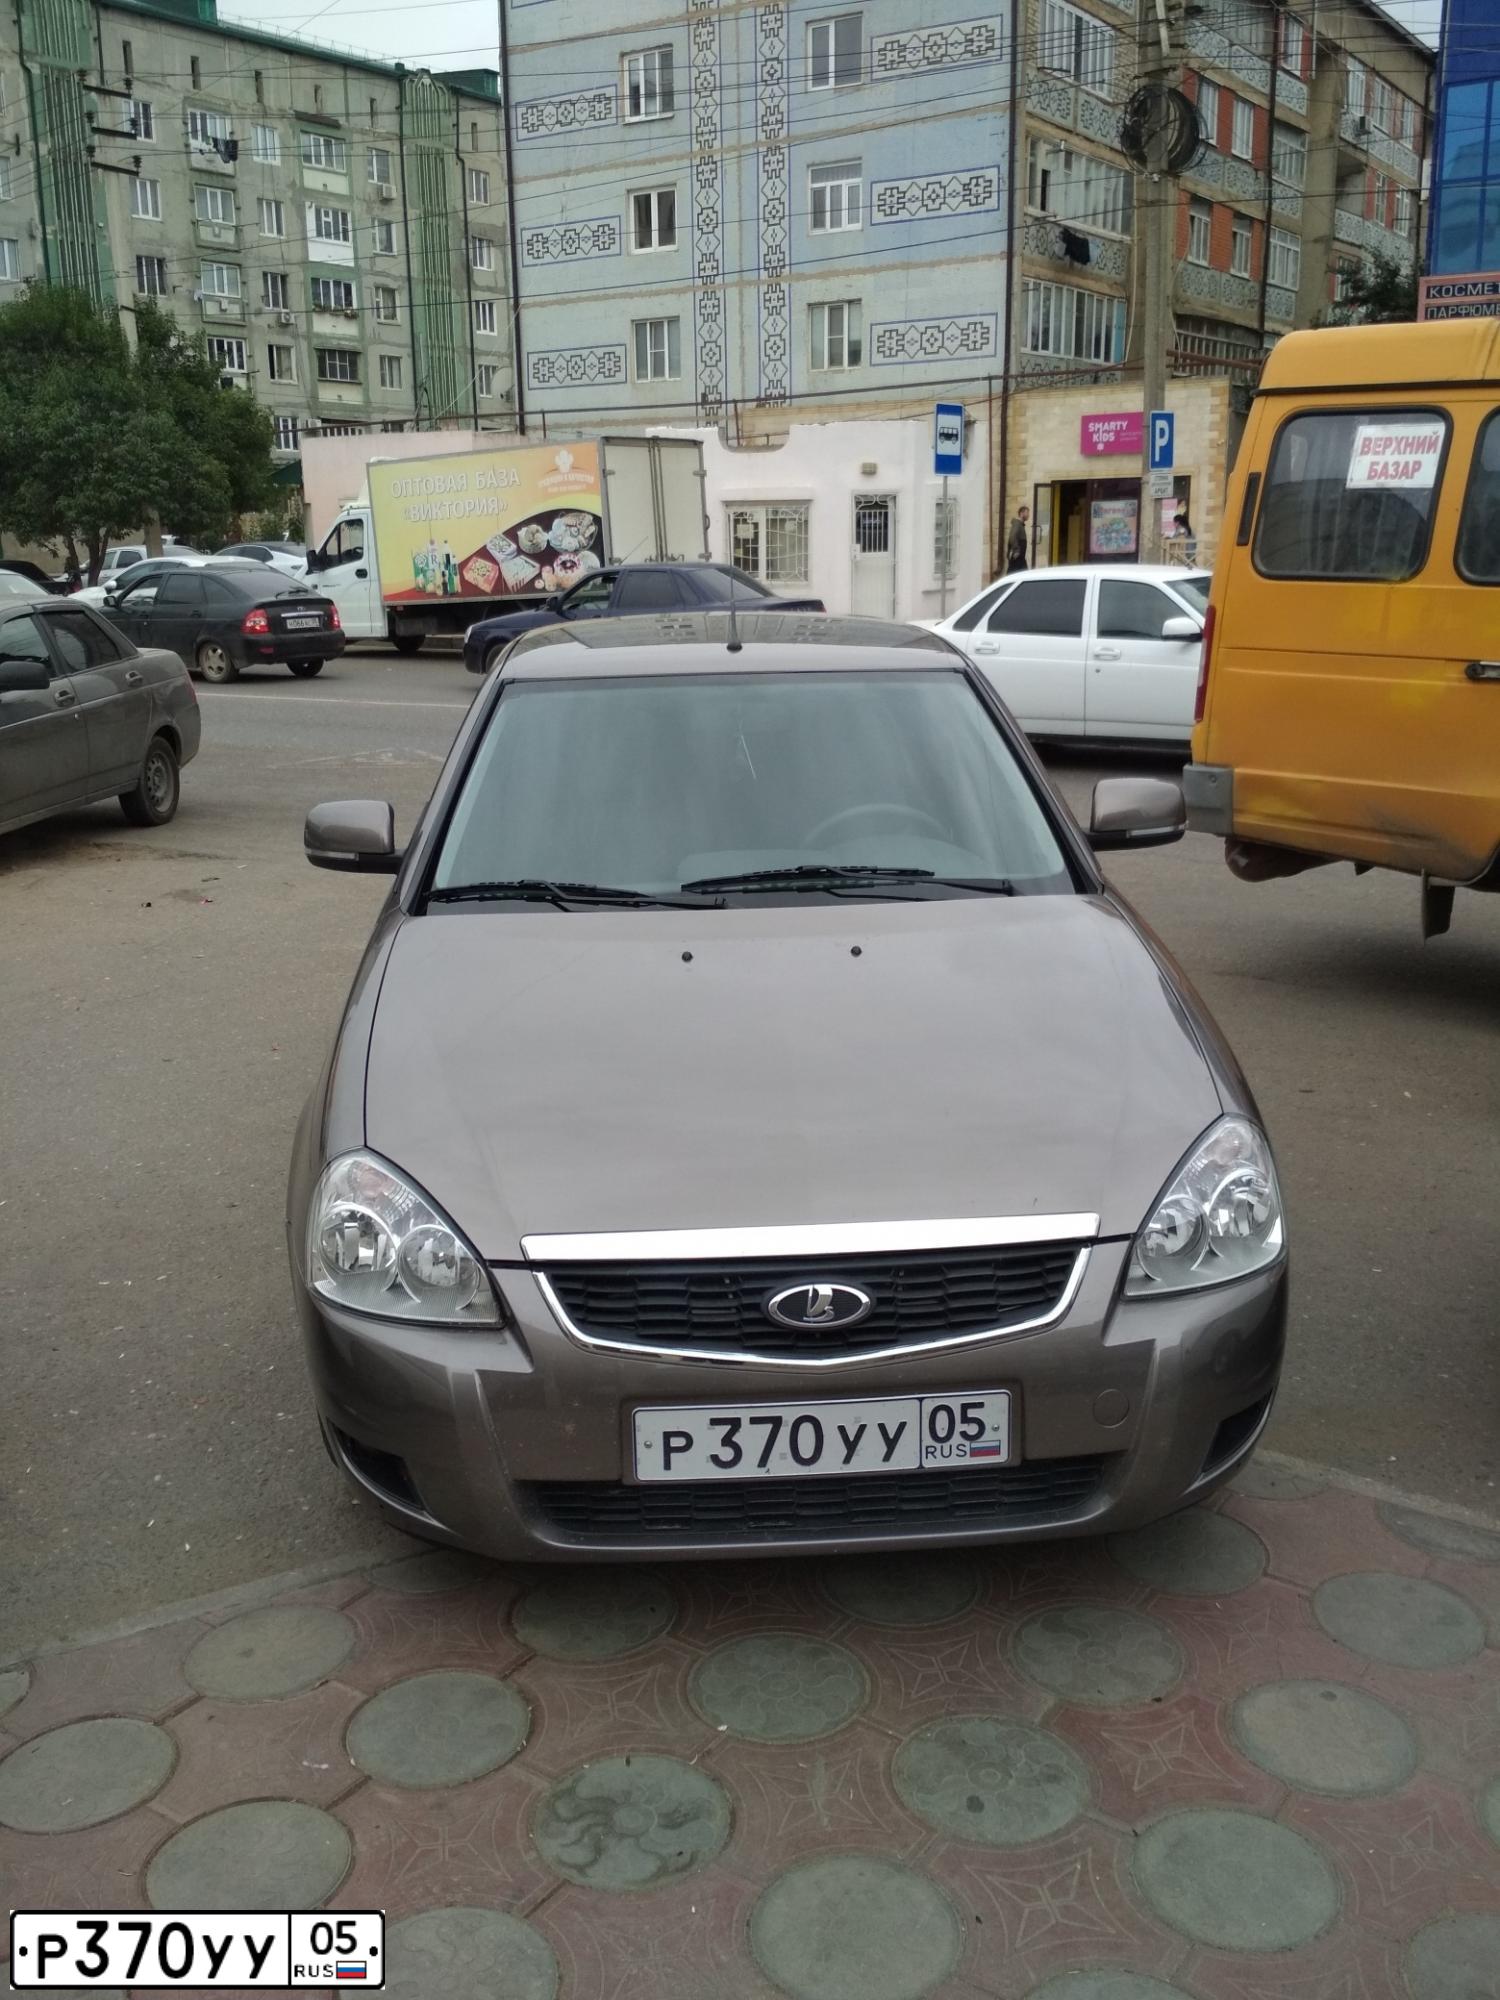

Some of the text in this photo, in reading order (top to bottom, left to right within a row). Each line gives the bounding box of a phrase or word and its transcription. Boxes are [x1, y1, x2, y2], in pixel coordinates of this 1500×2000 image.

[1088, 421, 1128, 432] SMARTY
[1092, 431, 1115, 443] KIDS
[1155, 419, 1169, 462] P
[1360, 431, 1440, 456] ВЕРХНИЙ
[1367, 460, 1422, 480] БАЗАР
[391, 473, 468, 499] ОПТОВАЯ
[475, 468, 521, 491] БАЗА
[403, 496, 509, 523] «ВИКТОРИЯ»
[928, 1401, 986, 1443] 05
[924, 1444, 967, 1460] RUS
